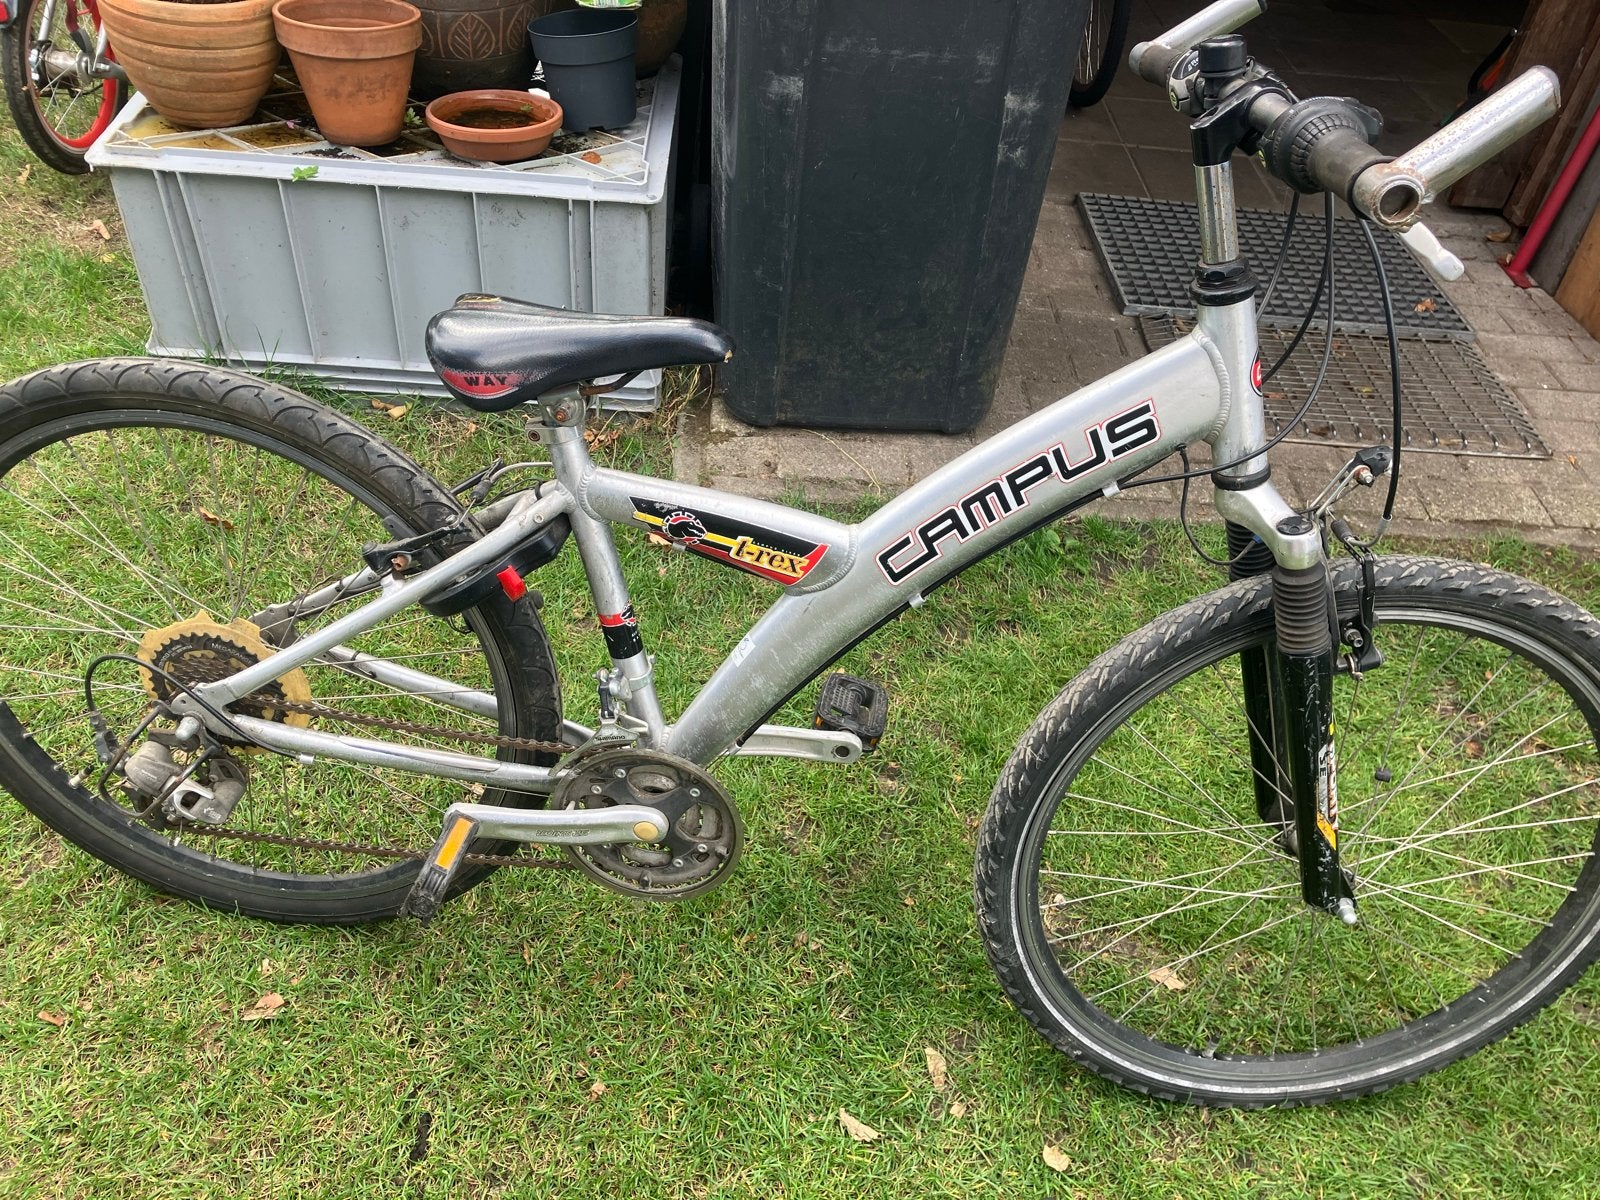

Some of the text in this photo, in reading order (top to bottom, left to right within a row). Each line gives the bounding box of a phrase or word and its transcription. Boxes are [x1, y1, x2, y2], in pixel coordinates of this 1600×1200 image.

[464, 375, 507, 387] WAY
[876, 400, 1160, 585] CAMPUS
[732, 539, 805, 575] t-rex
